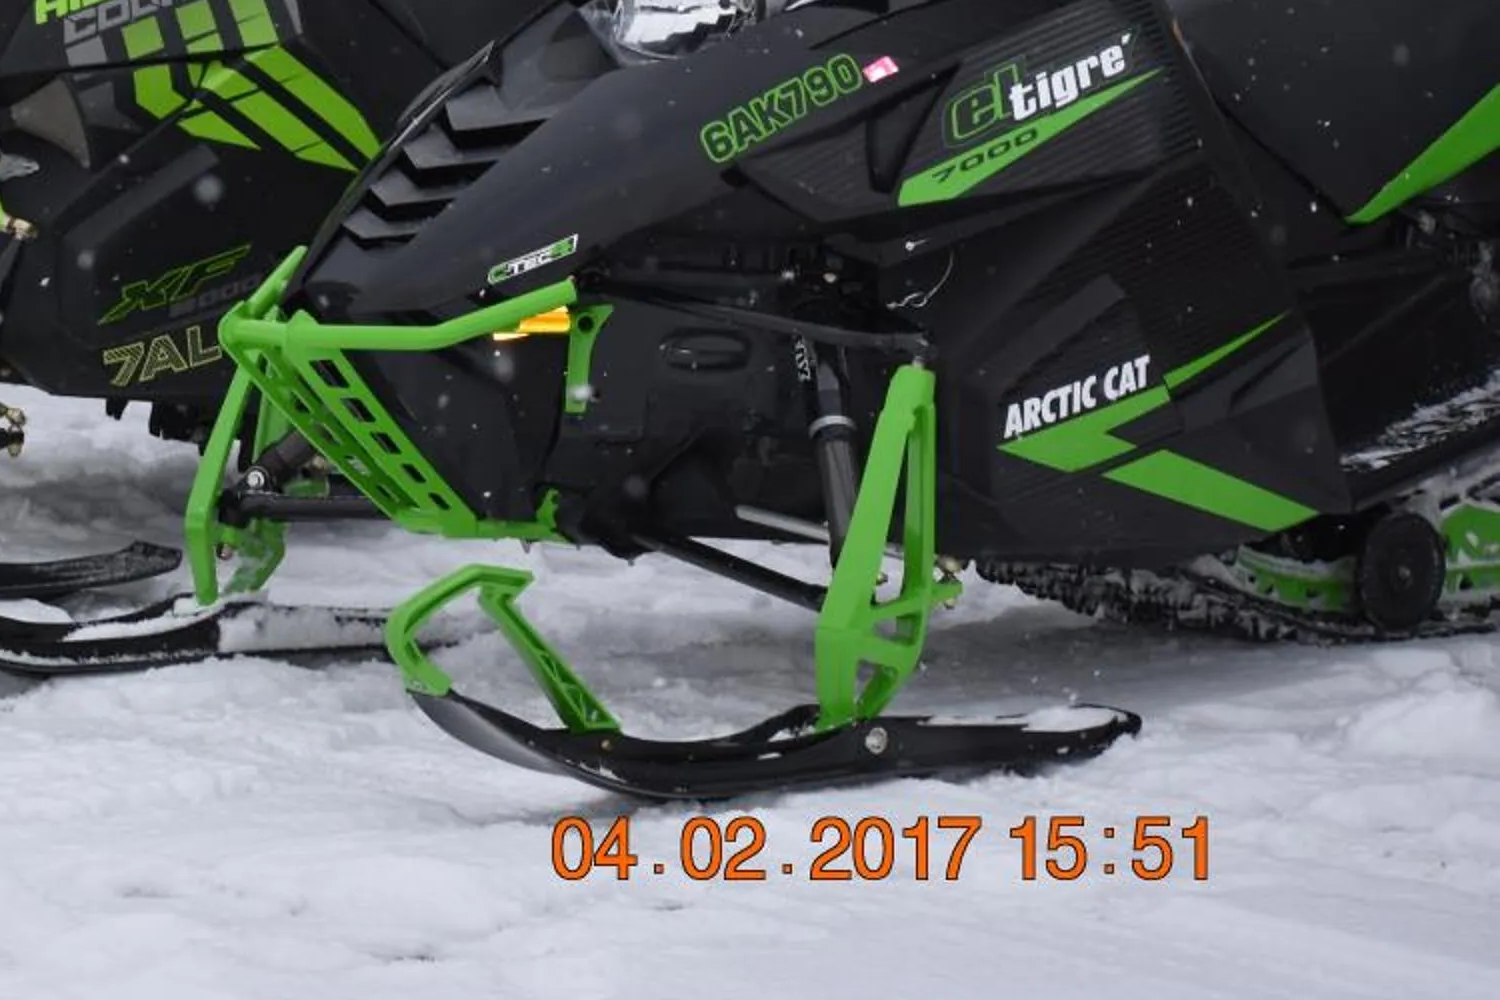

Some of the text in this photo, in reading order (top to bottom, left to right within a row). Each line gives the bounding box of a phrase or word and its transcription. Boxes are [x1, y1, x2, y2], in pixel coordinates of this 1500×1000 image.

[700, 53, 863, 164] 6AK790
[931, 126, 1039, 184] 7000
[1003, 354, 1151, 440] ARCTIC CAT
